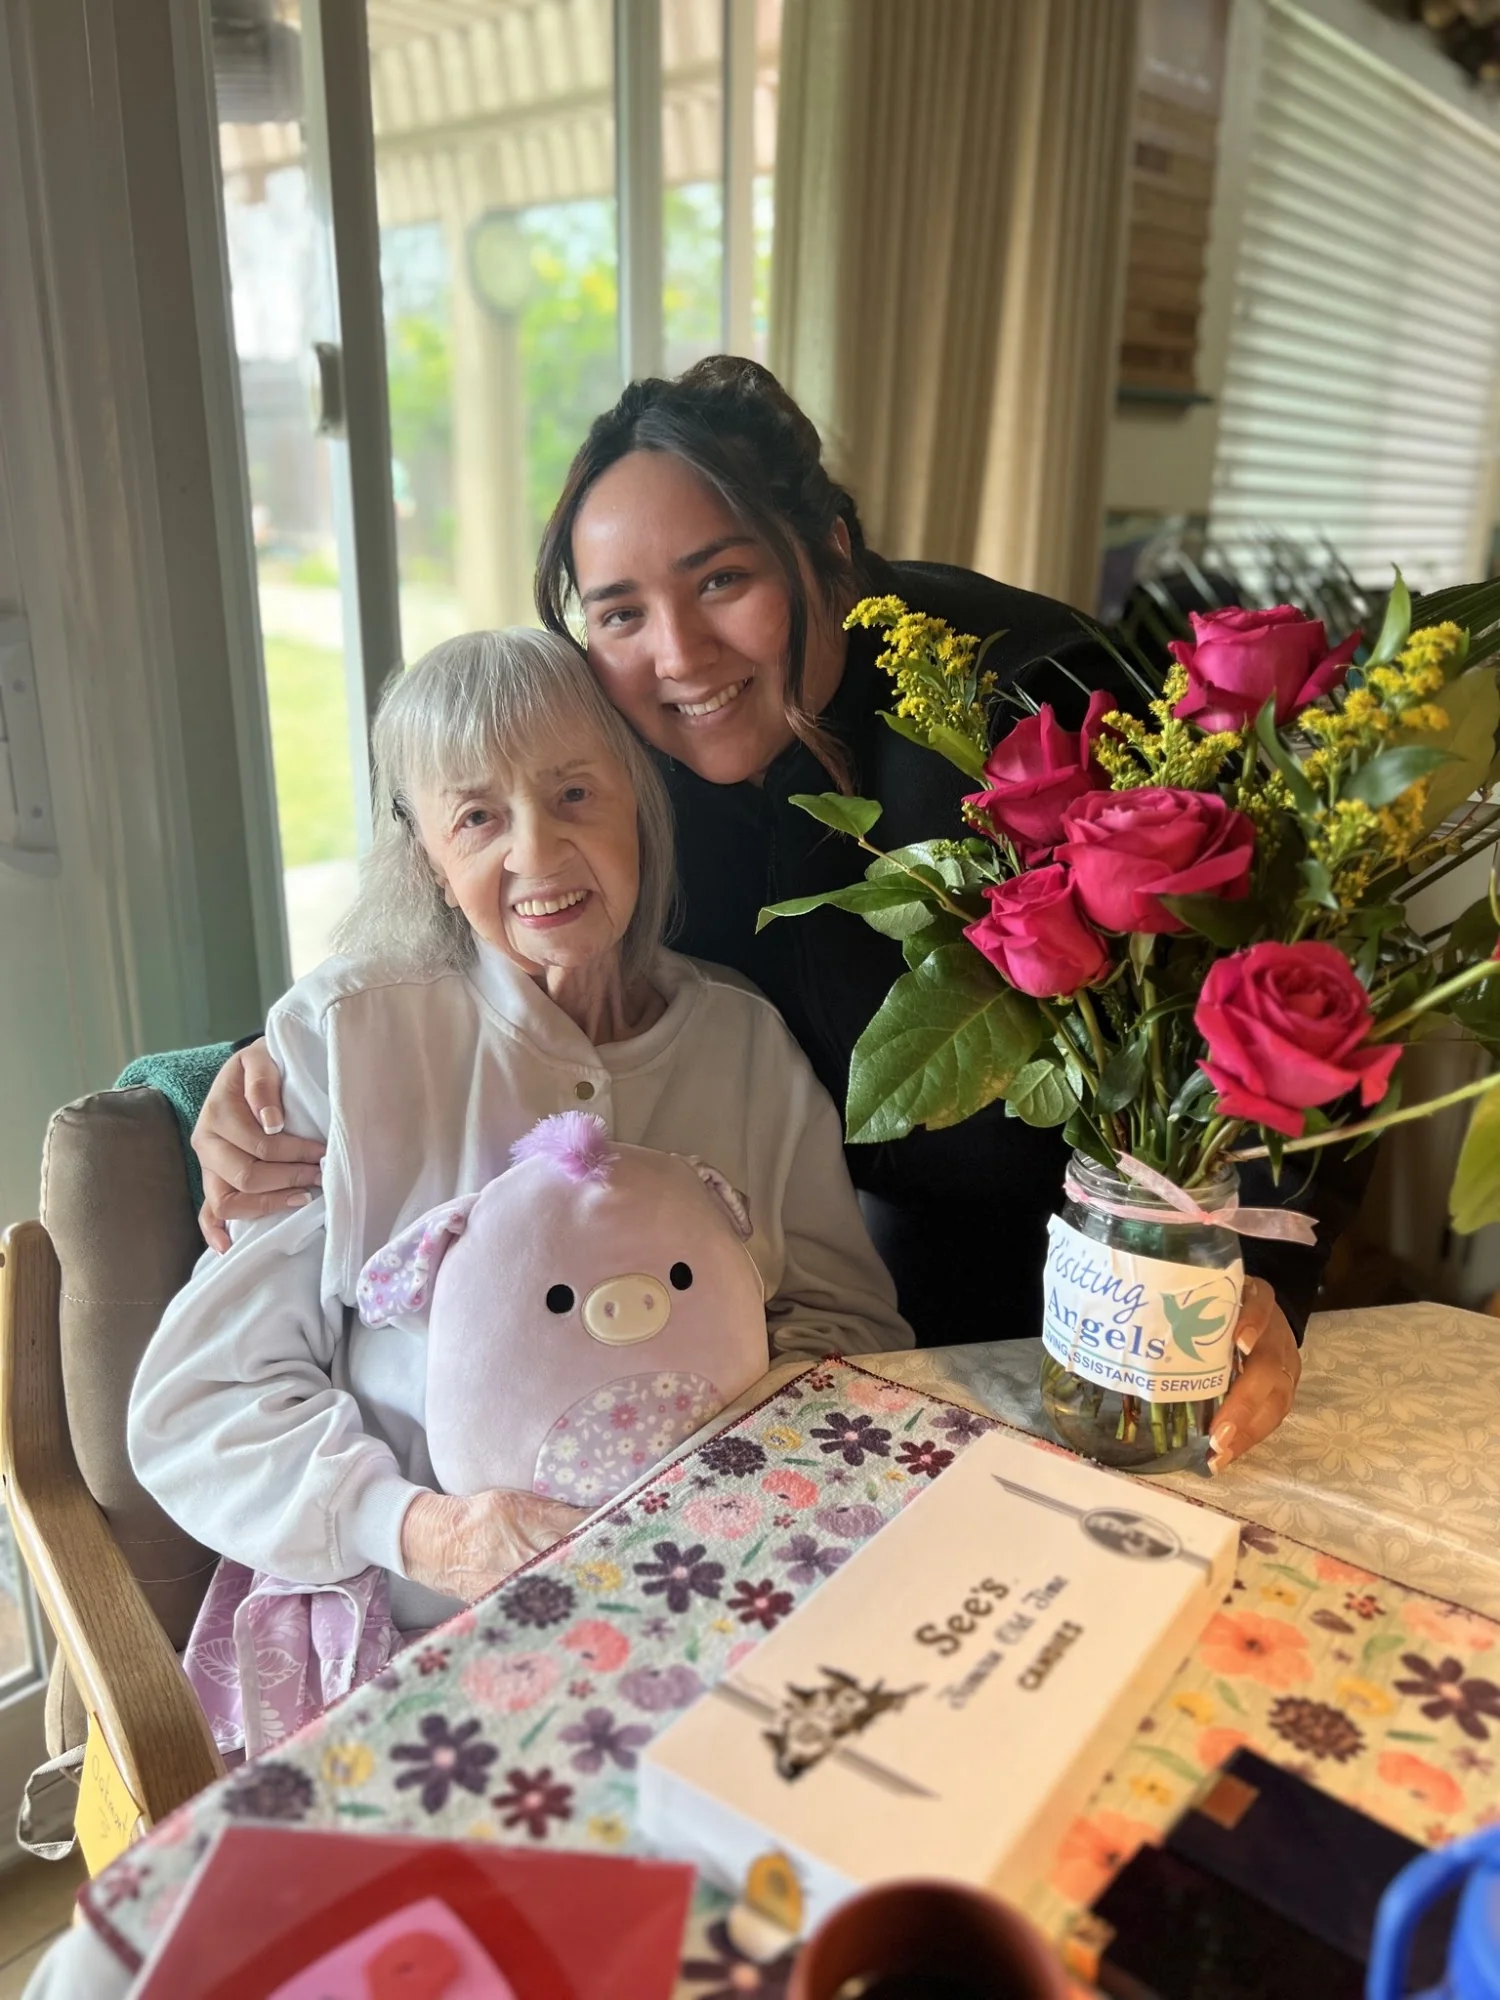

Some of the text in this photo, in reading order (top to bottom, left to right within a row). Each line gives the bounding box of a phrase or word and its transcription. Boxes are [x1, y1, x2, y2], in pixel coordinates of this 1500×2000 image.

[1047, 1287, 1166, 1360] Angels
[1160, 1374, 1223, 1391] SERVICES
[914, 1577, 1010, 1657] See's
